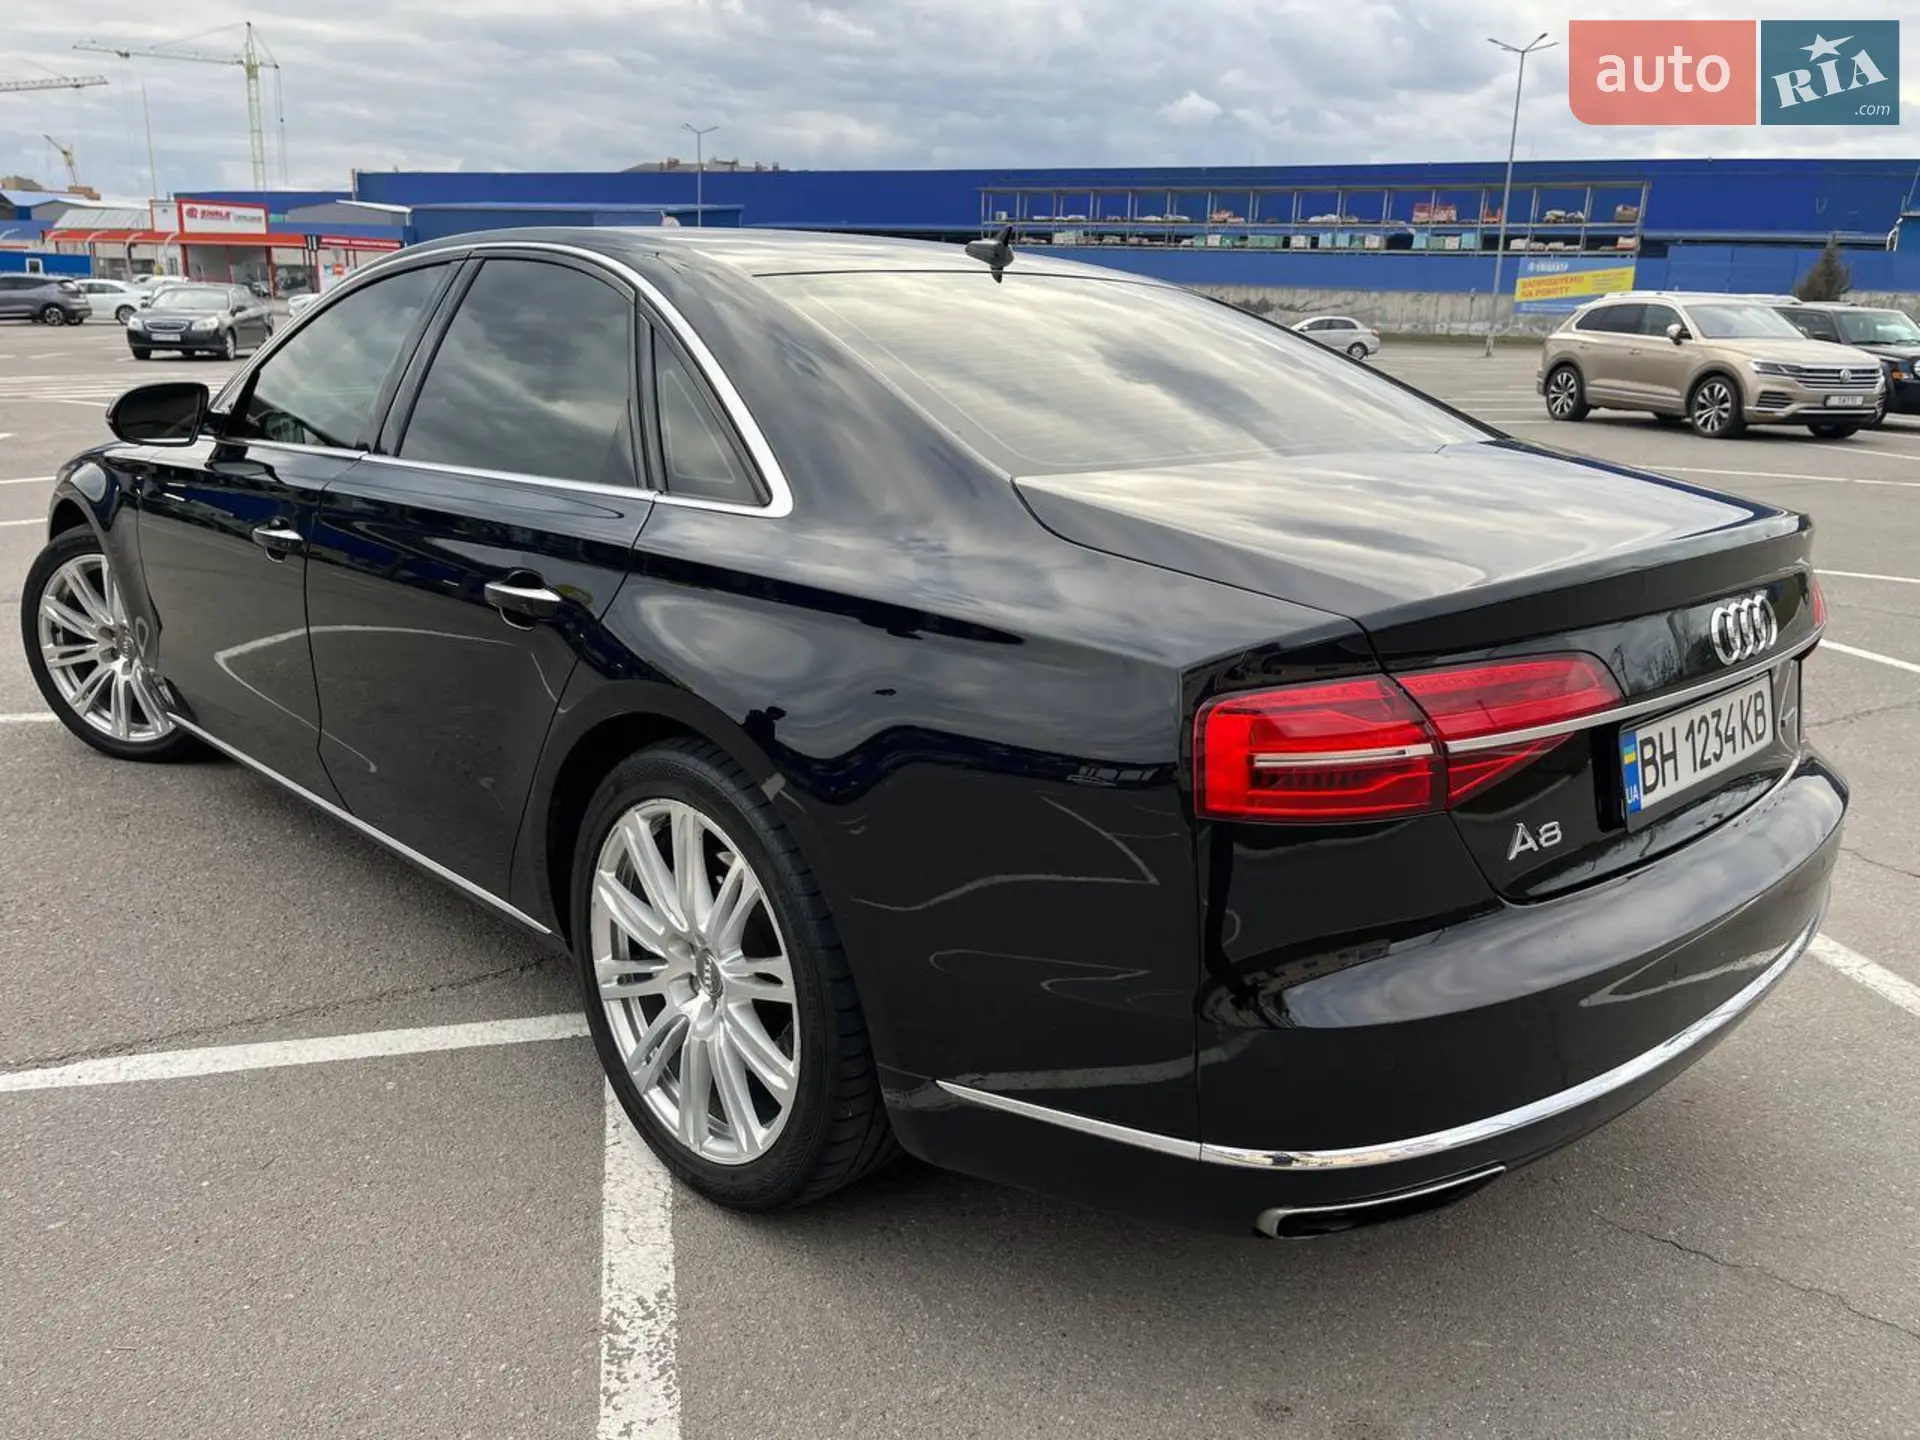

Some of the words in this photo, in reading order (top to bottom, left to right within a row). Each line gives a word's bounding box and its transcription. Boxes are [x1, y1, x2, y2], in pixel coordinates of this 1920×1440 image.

[1639, 726, 1678, 796] BH
[1685, 702, 1737, 774] 1234
[1740, 690, 1767, 751] KB
[1625, 784, 1641, 804] UA
[1508, 821, 1562, 861] A8
